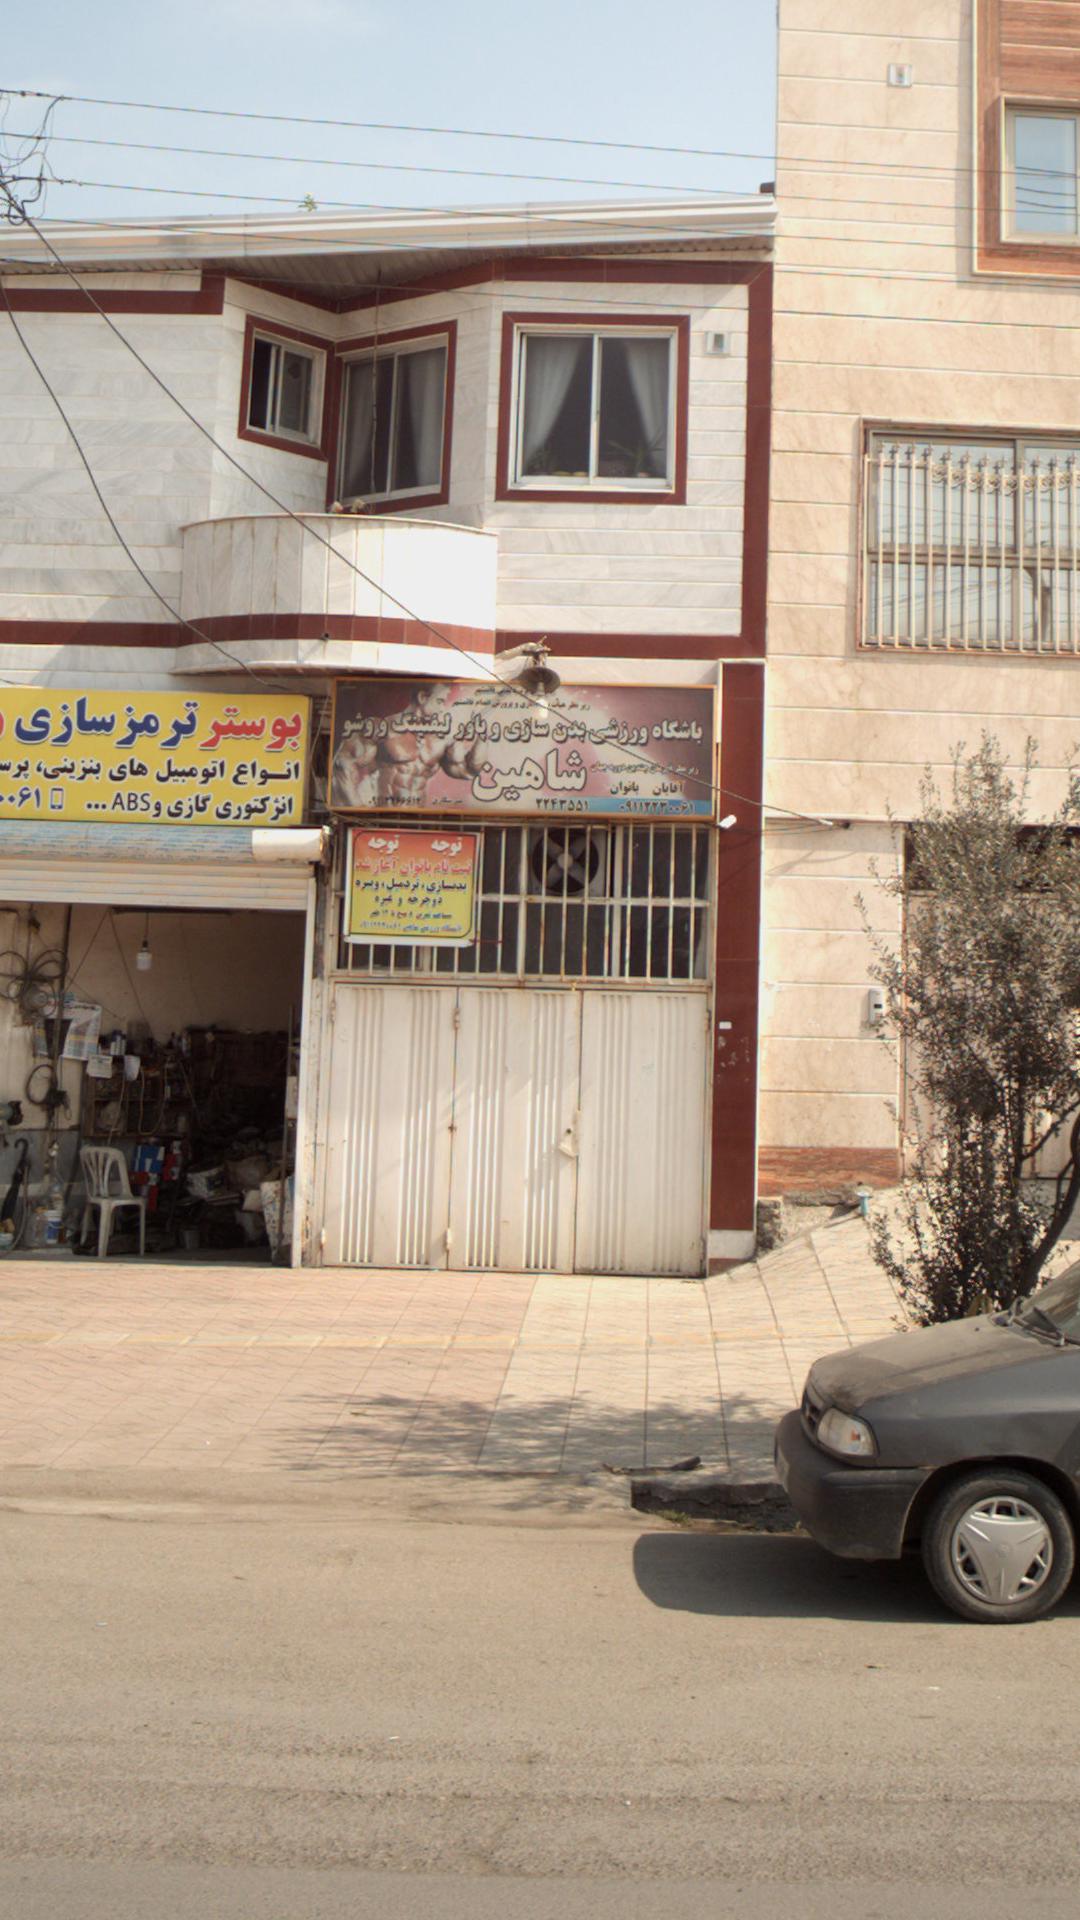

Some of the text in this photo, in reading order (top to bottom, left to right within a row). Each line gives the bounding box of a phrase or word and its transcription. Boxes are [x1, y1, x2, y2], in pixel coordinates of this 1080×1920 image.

[199, 707, 302, 751] بوستر
[588, 717, 649, 746] ورزشی
[652, 719, 703, 744] باشگاه
[109, 758, 148, 782] های
[156, 758, 225, 785] اتومبیل
[232, 760, 300, 786] انواع
[471, 748, 587, 802] شاهین
[610, 781, 639, 796] بانوان
[167, 793, 211, 819] گازی
[367, 834, 463, 857] توجه توجه
